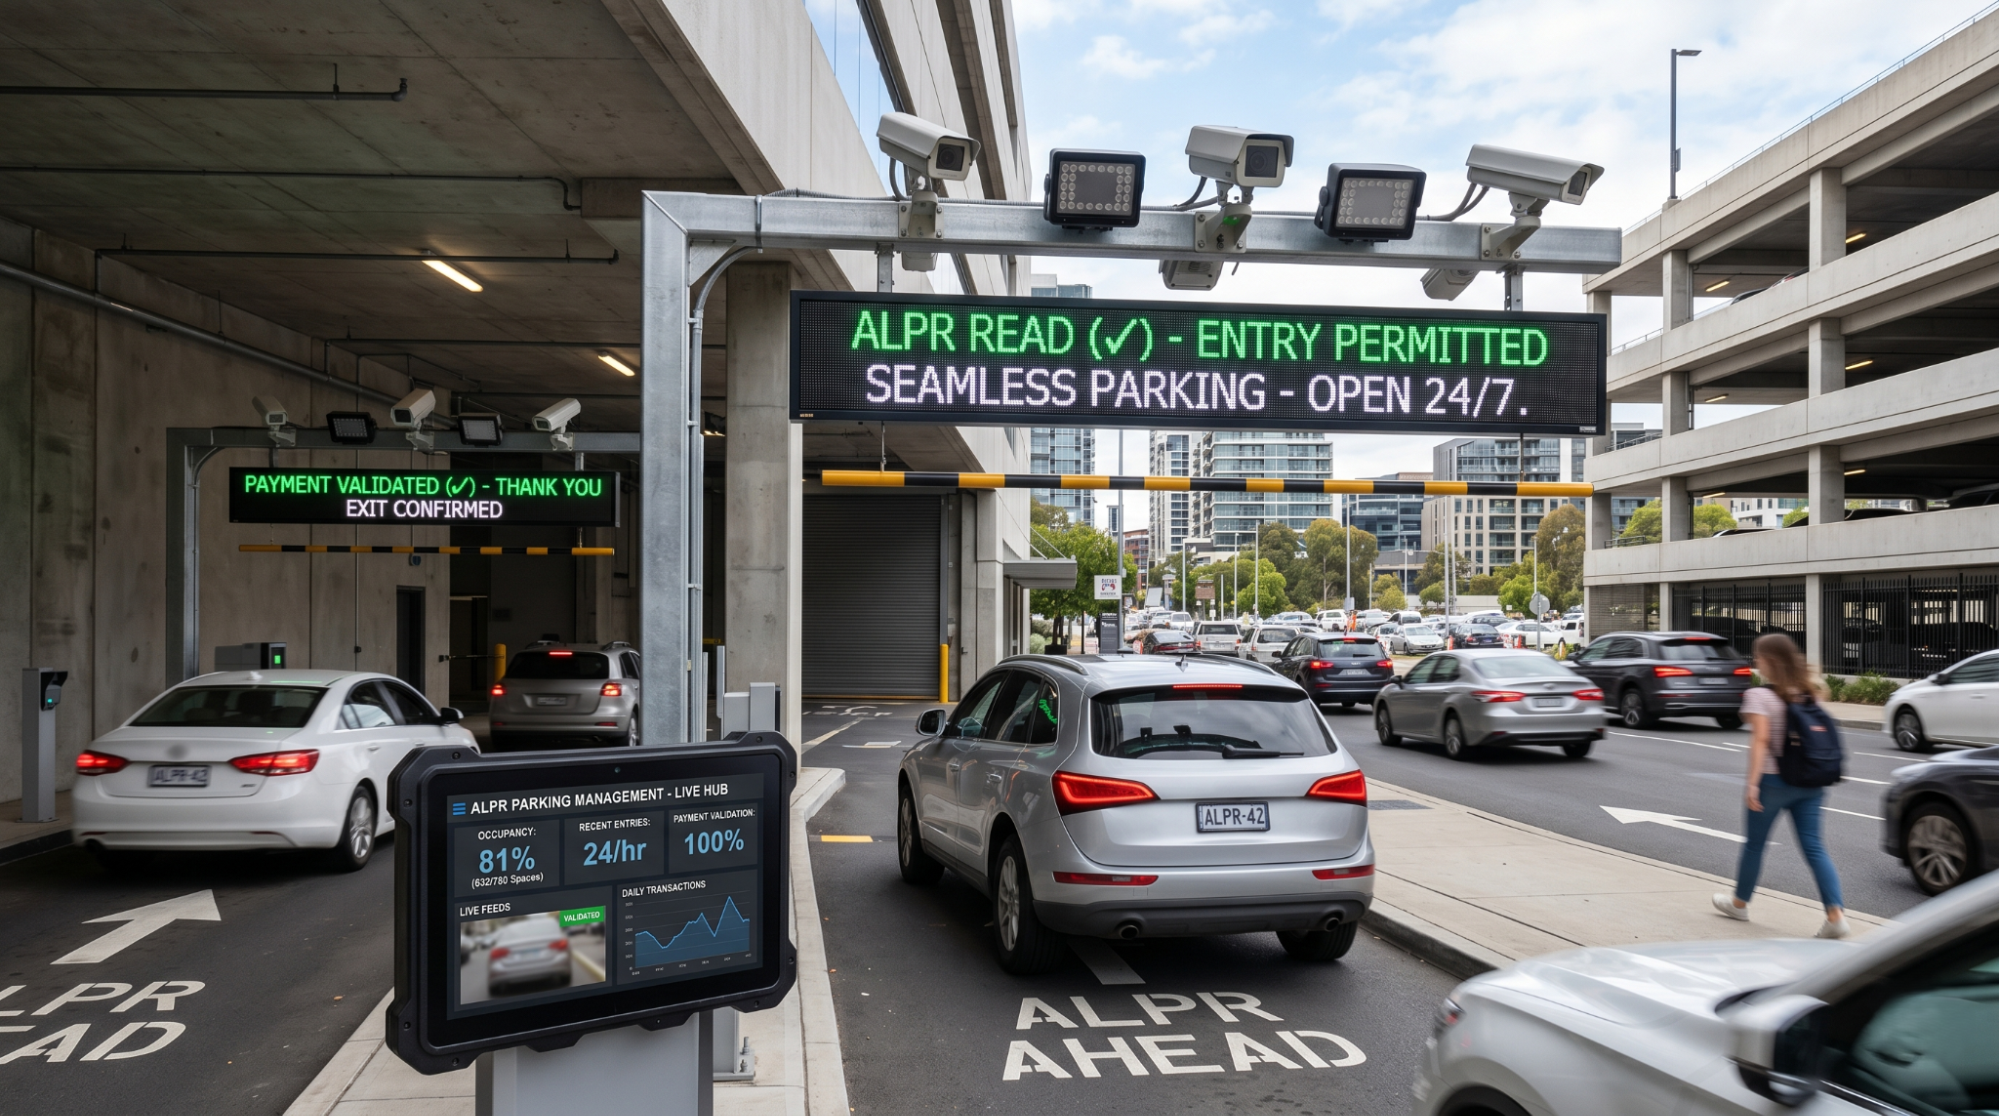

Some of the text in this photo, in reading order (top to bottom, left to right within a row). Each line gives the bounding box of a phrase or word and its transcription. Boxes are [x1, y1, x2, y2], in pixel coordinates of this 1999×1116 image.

[852, 310, 956, 352] ALPR
[970, 313, 1074, 354] READ
[1198, 319, 1321, 361] ENTRY
[1335, 323, 1549, 366] PERMITTED
[866, 364, 1076, 406] SEAMLESS
[1091, 369, 1266, 411] PARKING
[1308, 375, 1411, 414] OPEN
[1425, 377, 1528, 418] 24/7.
[245, 475, 332, 494] PAYMENT
[336, 476, 440, 495] VALIDATED
[495, 477, 558, 496] THANK
[563, 478, 602, 497] YOU
[346, 499, 503, 519] EXIT CONFIRMED
[470, 799, 508, 815] ALPR
[511, 794, 571, 812] PARKING
[575, 787, 664, 806] MANAGEMENT
[674, 785, 701, 799] LIVE
[703, 783, 729, 797] HUB
[579, 818, 651, 832] RECENT ENTRIES:
[673, 809, 756, 823] PAYMENT VALIDATION:
[1205, 807, 1265, 826] ALPR-42
[478, 827, 537, 841] OCCUPANCY:
[684, 828, 744, 856] 100%
[479, 845, 536, 874] 81%
[583, 839, 647, 866] 24/hr
[471, 872, 544, 890] (632/780 Spaces)
[622, 879, 706, 898] DAILY TRANSACTIONS
[459, 902, 511, 917] LIVE FEEDS
[1016, 991, 1285, 1030] ALPR
[1002, 1030, 1368, 1081] AHEAD
